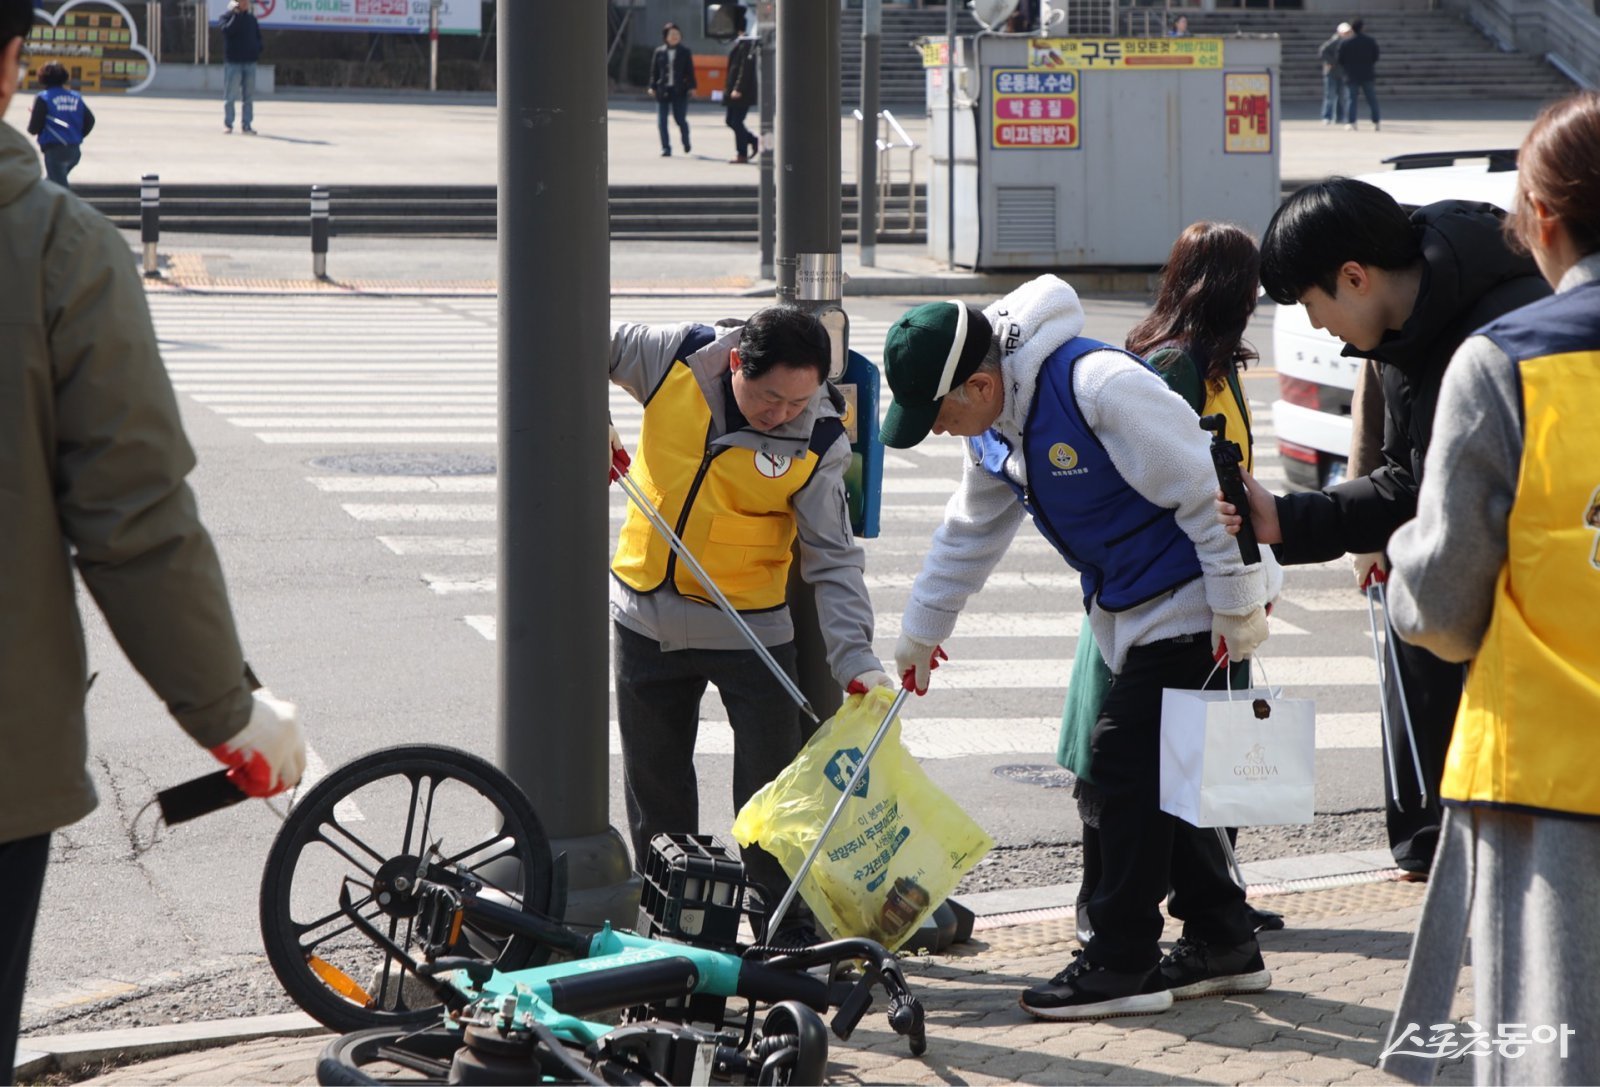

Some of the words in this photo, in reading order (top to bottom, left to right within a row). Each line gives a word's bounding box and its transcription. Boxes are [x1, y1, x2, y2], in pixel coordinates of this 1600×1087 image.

[1081, 41, 1121, 66] 구두
[1233, 765, 1279, 776] GODIVA
[827, 834, 868, 863] 남양주시
[853, 848, 892, 881] 수거전용
